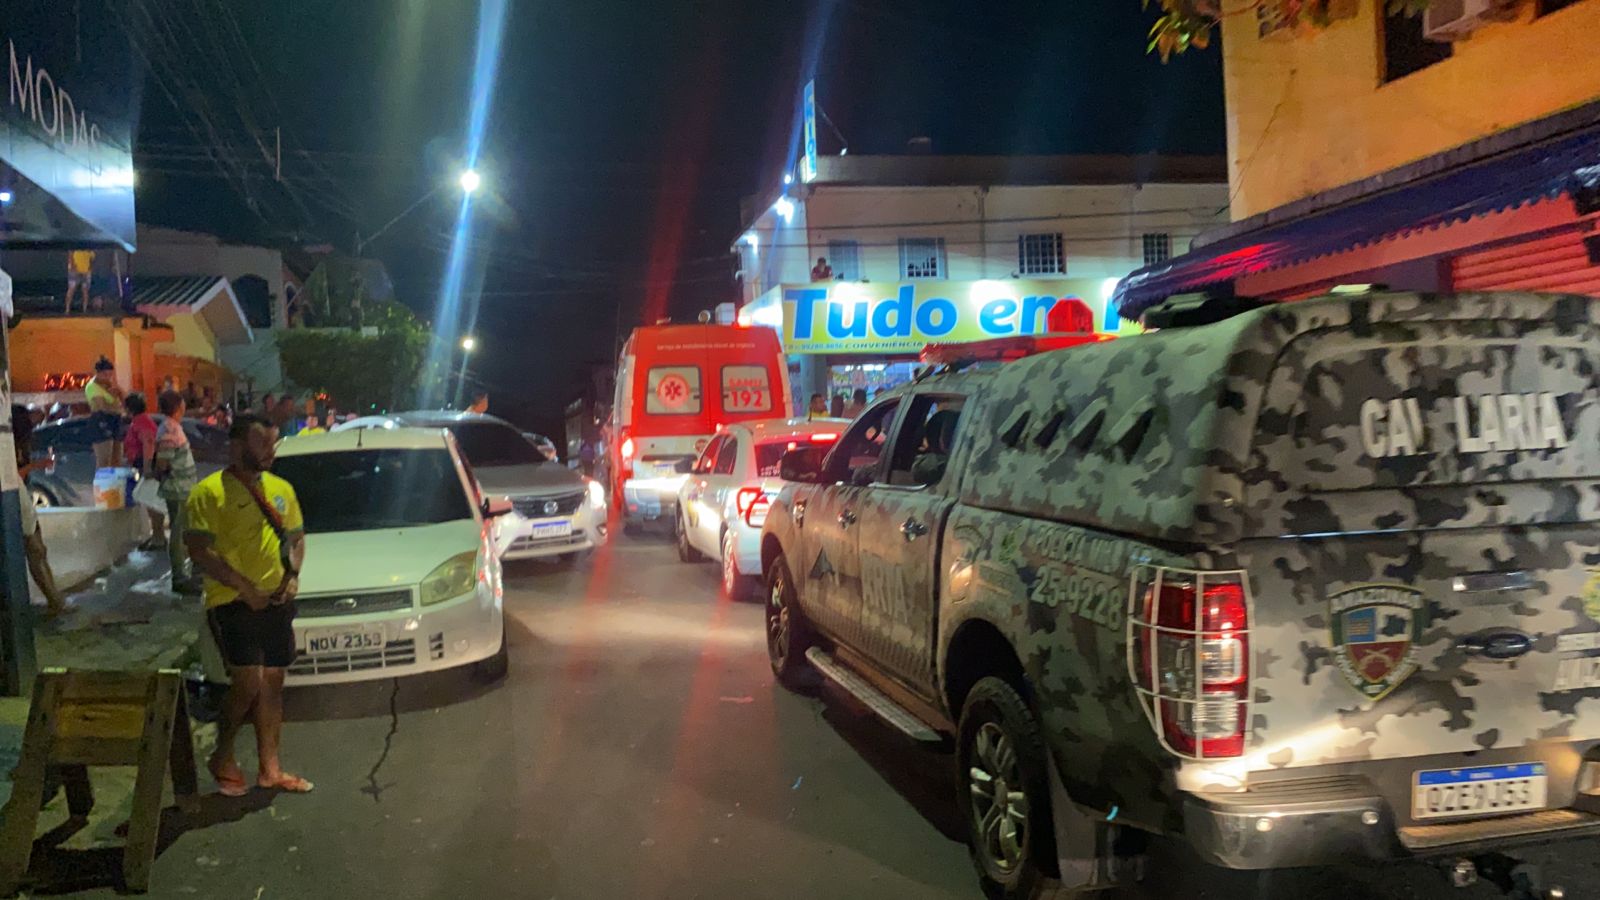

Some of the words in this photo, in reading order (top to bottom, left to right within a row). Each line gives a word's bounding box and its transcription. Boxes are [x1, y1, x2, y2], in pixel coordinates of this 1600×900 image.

[784, 284, 958, 340] Tudo
[731, 391, 762, 408] 192
[310, 637, 337, 651] NOV
